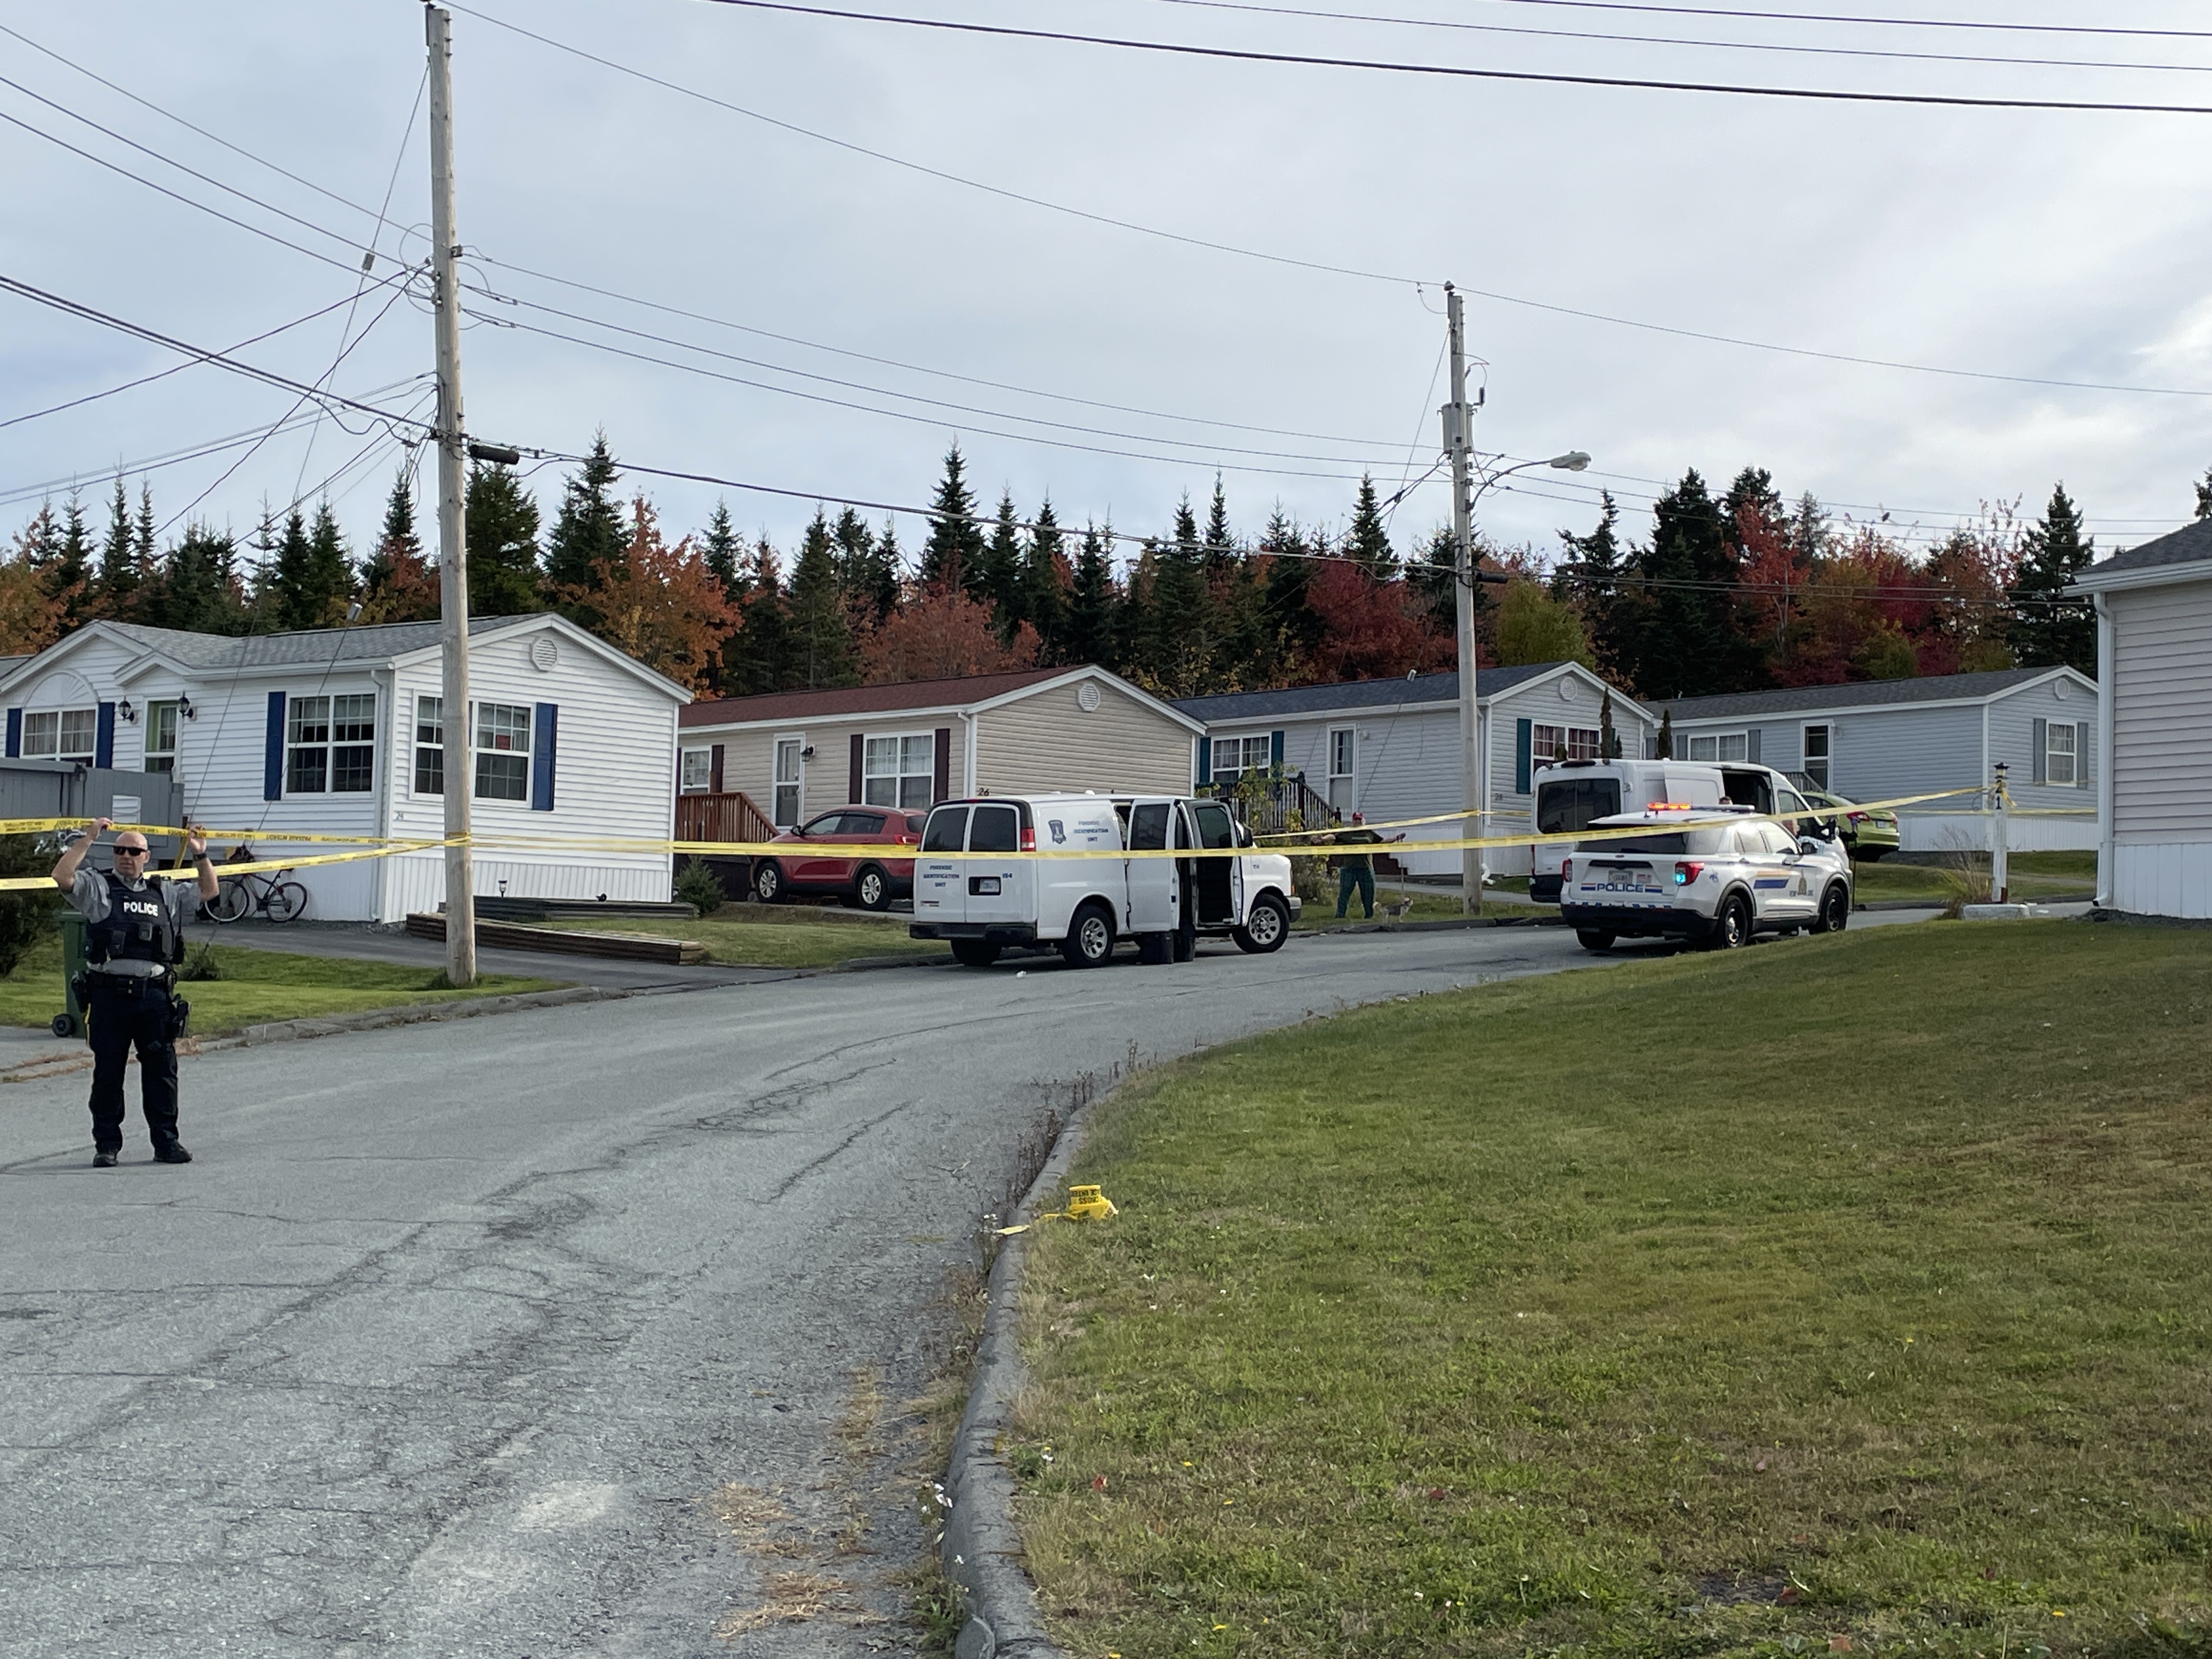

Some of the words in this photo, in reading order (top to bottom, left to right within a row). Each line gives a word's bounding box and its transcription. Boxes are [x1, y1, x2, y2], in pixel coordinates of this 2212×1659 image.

[978, 787, 990, 797] 26
[1597, 883, 1643, 892] POLICE
[123, 901, 159, 917] POLICE
